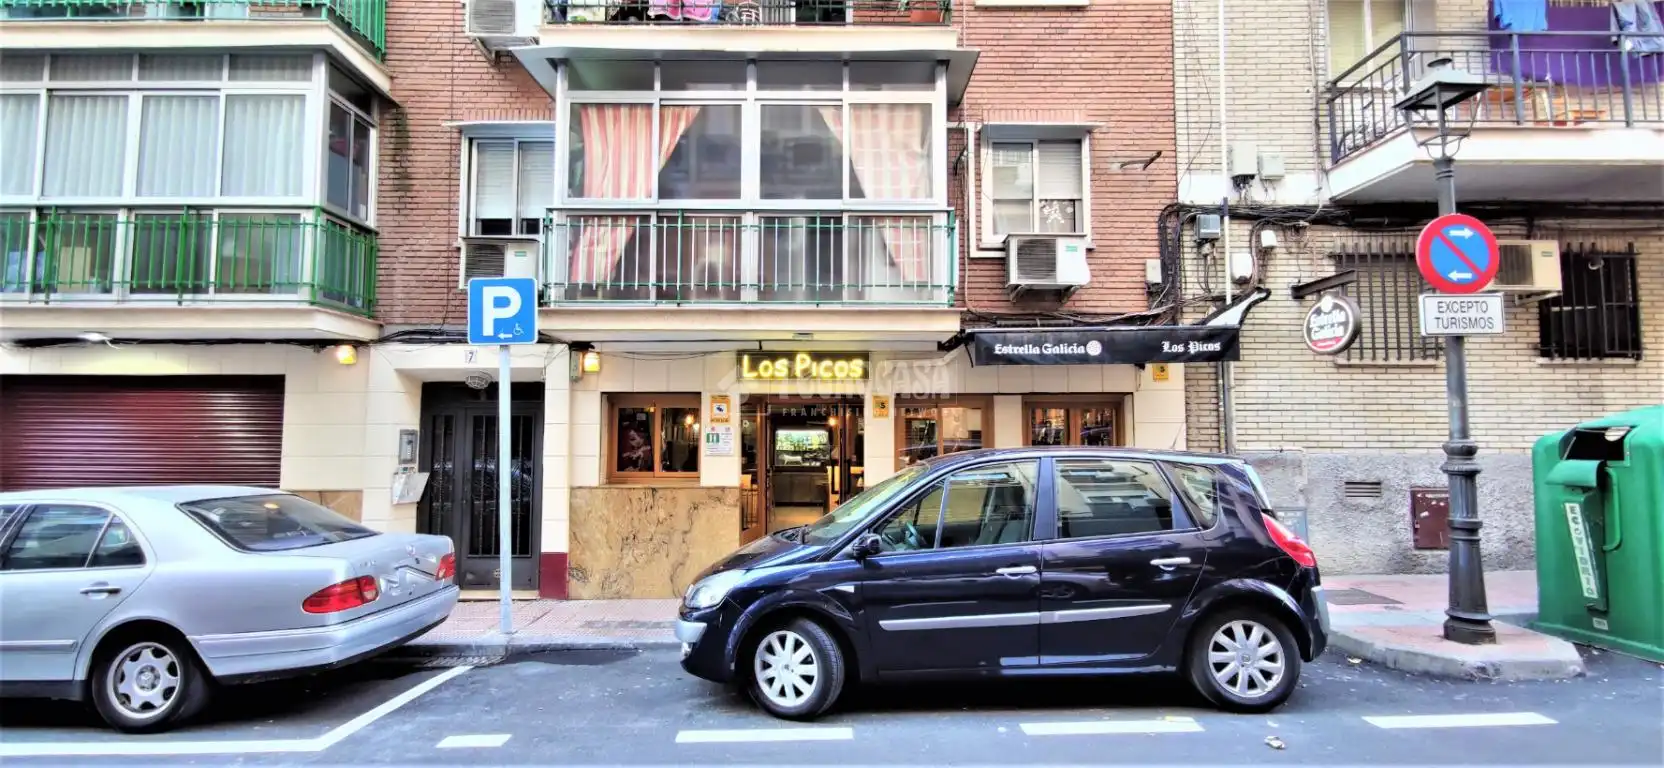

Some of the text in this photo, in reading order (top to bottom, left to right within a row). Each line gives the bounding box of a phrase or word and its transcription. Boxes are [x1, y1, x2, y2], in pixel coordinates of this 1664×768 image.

[482, 286, 522, 337] P
[1437, 301, 1488, 314] EXCEPTO
[1434, 317, 1494, 329] TURISMOS
[994, 343, 1085, 354] Estrella Galicia
[1161, 341, 1221, 354] Los Picos
[467, 351, 475, 364] 7
